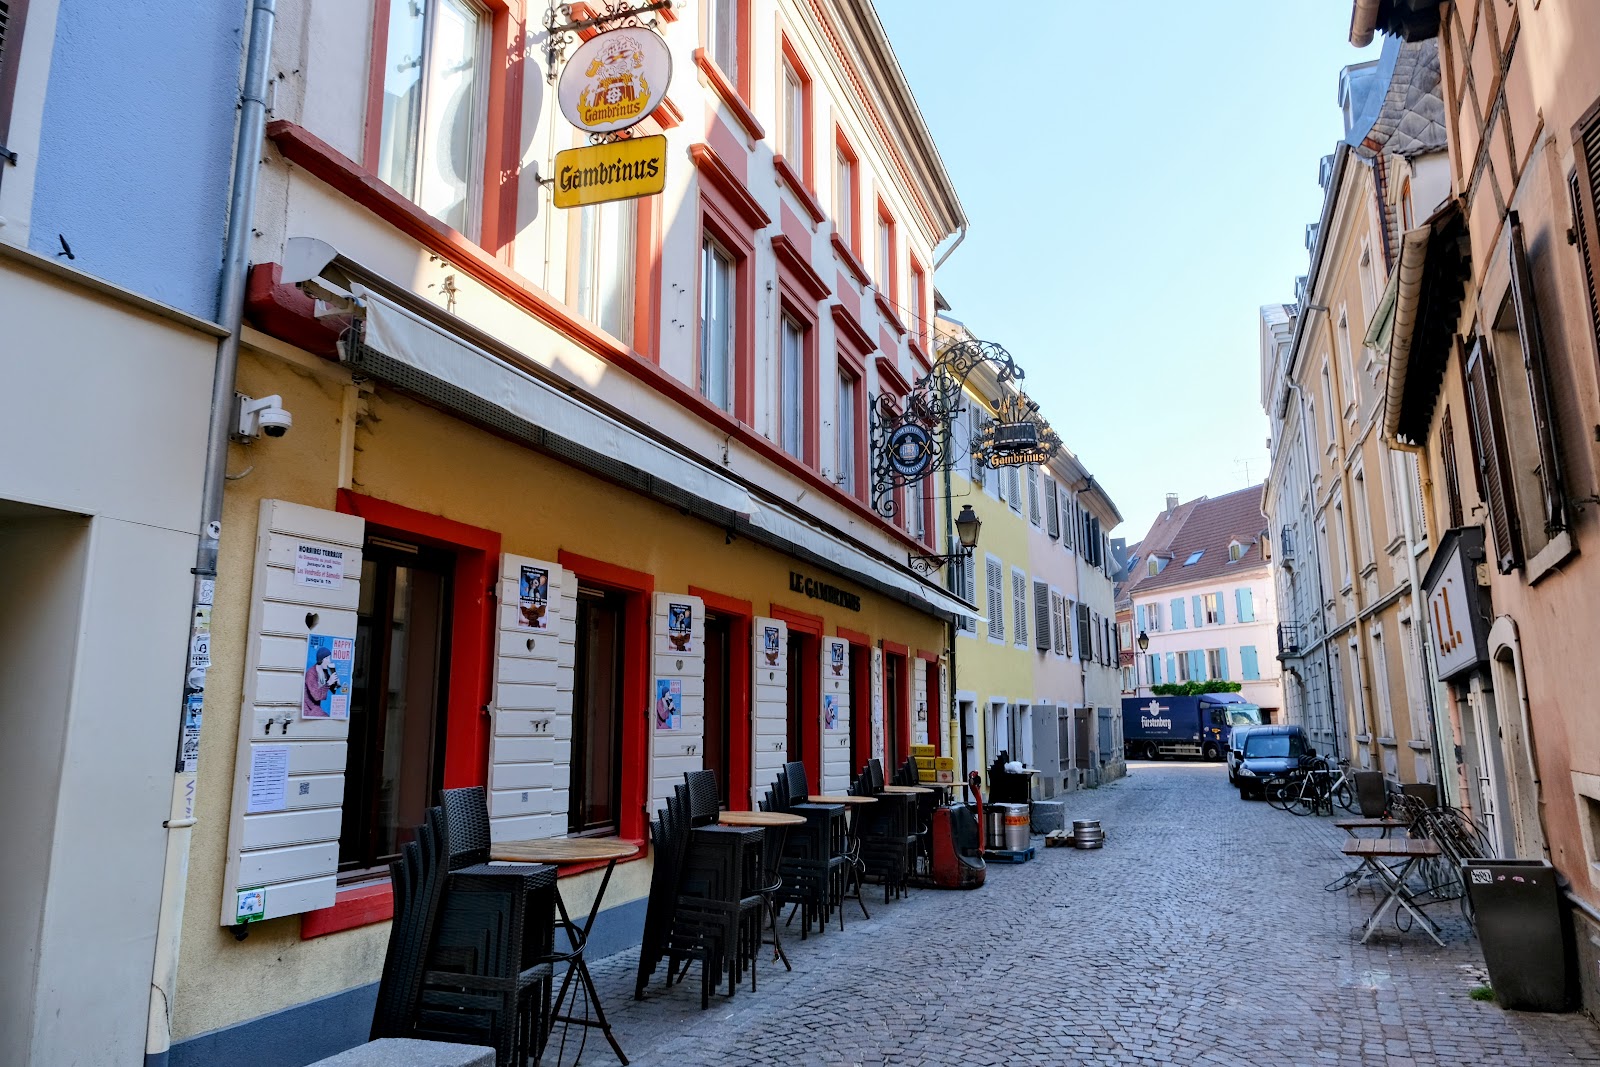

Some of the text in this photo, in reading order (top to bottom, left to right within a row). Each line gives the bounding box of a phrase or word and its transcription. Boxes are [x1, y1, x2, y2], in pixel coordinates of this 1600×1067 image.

[584, 102, 641, 122] Gambrinus
[560, 157, 660, 193] Gambrinus
[991, 451, 1045, 466] Gambrinus
[299, 546, 343, 559] HORAIRES TERRASSE
[789, 571, 804, 593] LE
[334, 640, 352, 649] HAPPY
[333, 649, 350, 660] HOUR
